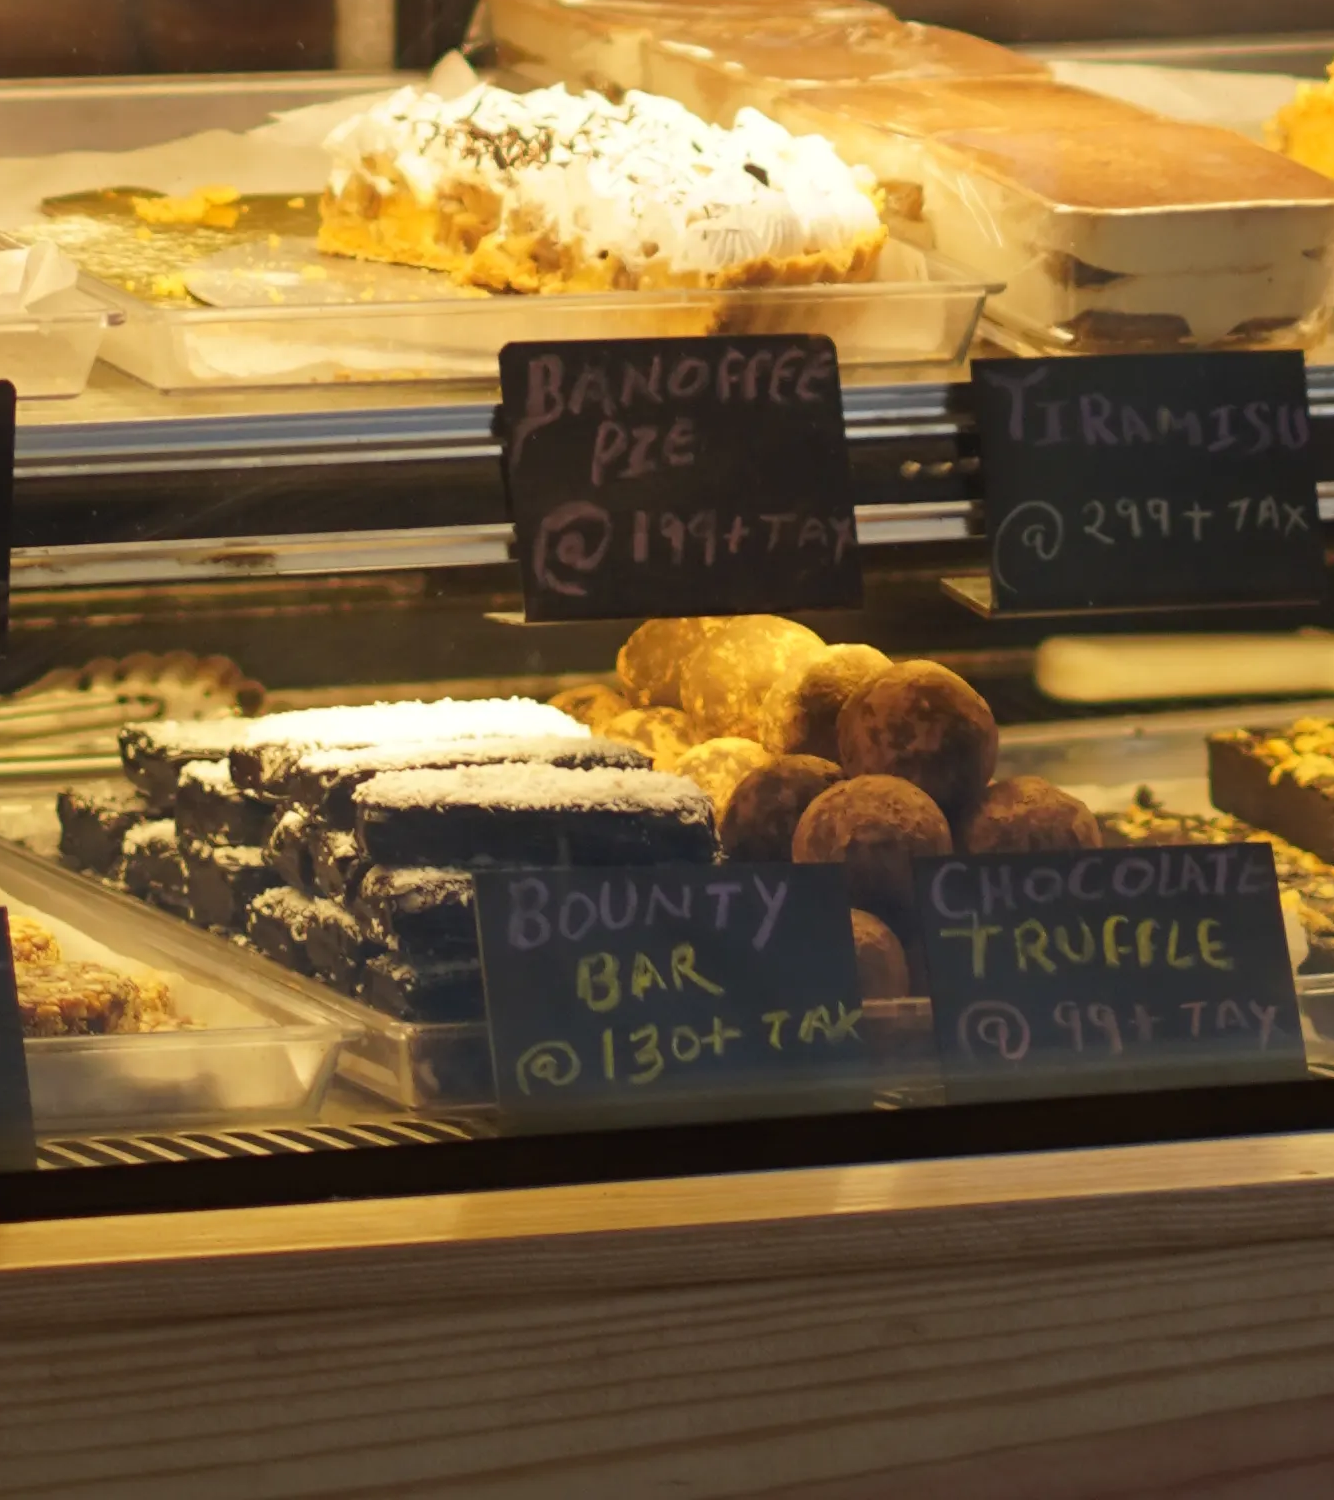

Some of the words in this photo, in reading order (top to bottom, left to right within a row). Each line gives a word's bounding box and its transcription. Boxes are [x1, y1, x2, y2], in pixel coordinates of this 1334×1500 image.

[523, 346, 834, 423] BANOFFEE
[982, 366, 1311, 454] TIRAMISU
[1082, 497, 1171, 546] 299
[1228, 496, 1309, 537] TAX
[508, 873, 789, 951] BOUNTY
[932, 849, 1271, 919] CHOCOLATE
[577, 942, 727, 1013] BAR
[940, 914, 1235, 978] TRUFFLE
[762, 1002, 864, 1051] TAX
